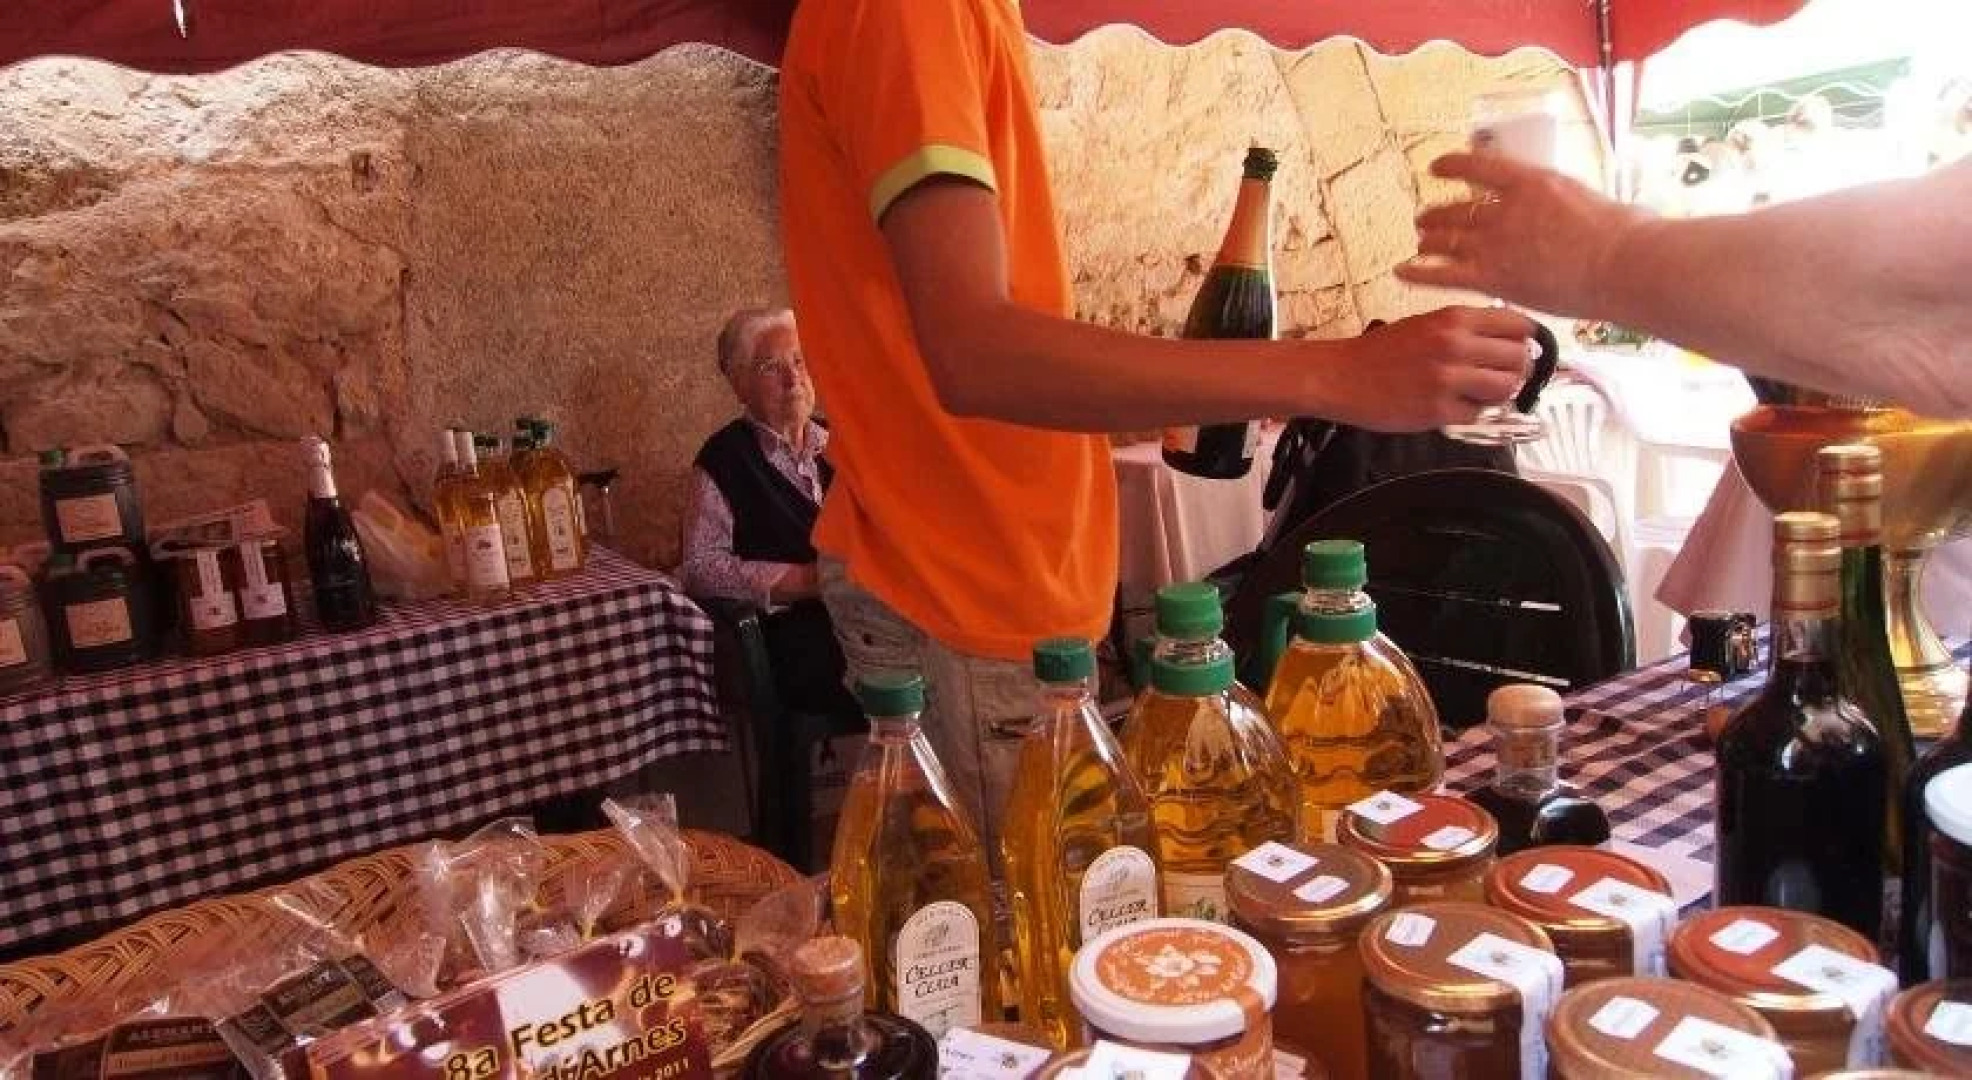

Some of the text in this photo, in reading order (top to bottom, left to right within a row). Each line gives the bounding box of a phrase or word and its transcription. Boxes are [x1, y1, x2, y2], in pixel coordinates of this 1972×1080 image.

[447, 974, 677, 1080] 8a Festa de
